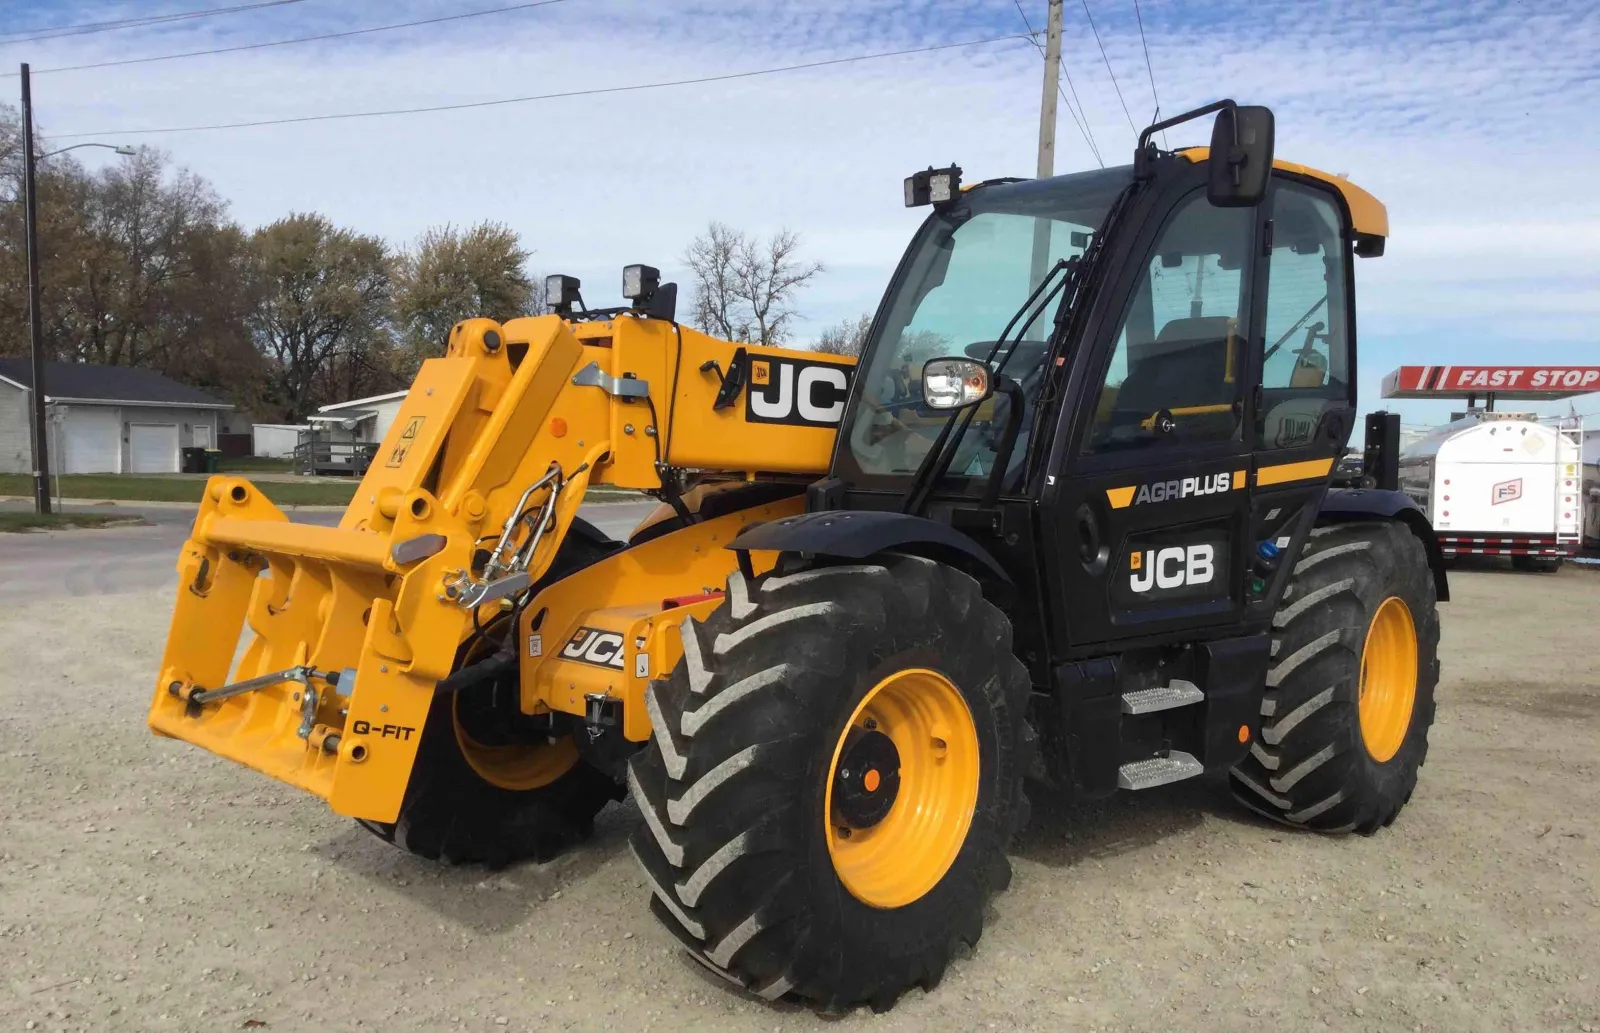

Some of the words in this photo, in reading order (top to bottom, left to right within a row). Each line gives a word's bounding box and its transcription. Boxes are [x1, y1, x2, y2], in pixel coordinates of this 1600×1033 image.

[1457, 370, 1524, 386] FAST
[1530, 370, 1600, 387] STOP
[751, 363, 854, 423] JC
[1135, 472, 1230, 506] AGRIPLUS
[1498, 484, 1517, 498] FS
[1130, 544, 1214, 592] JCB
[353, 720, 416, 741] Q-FIT
